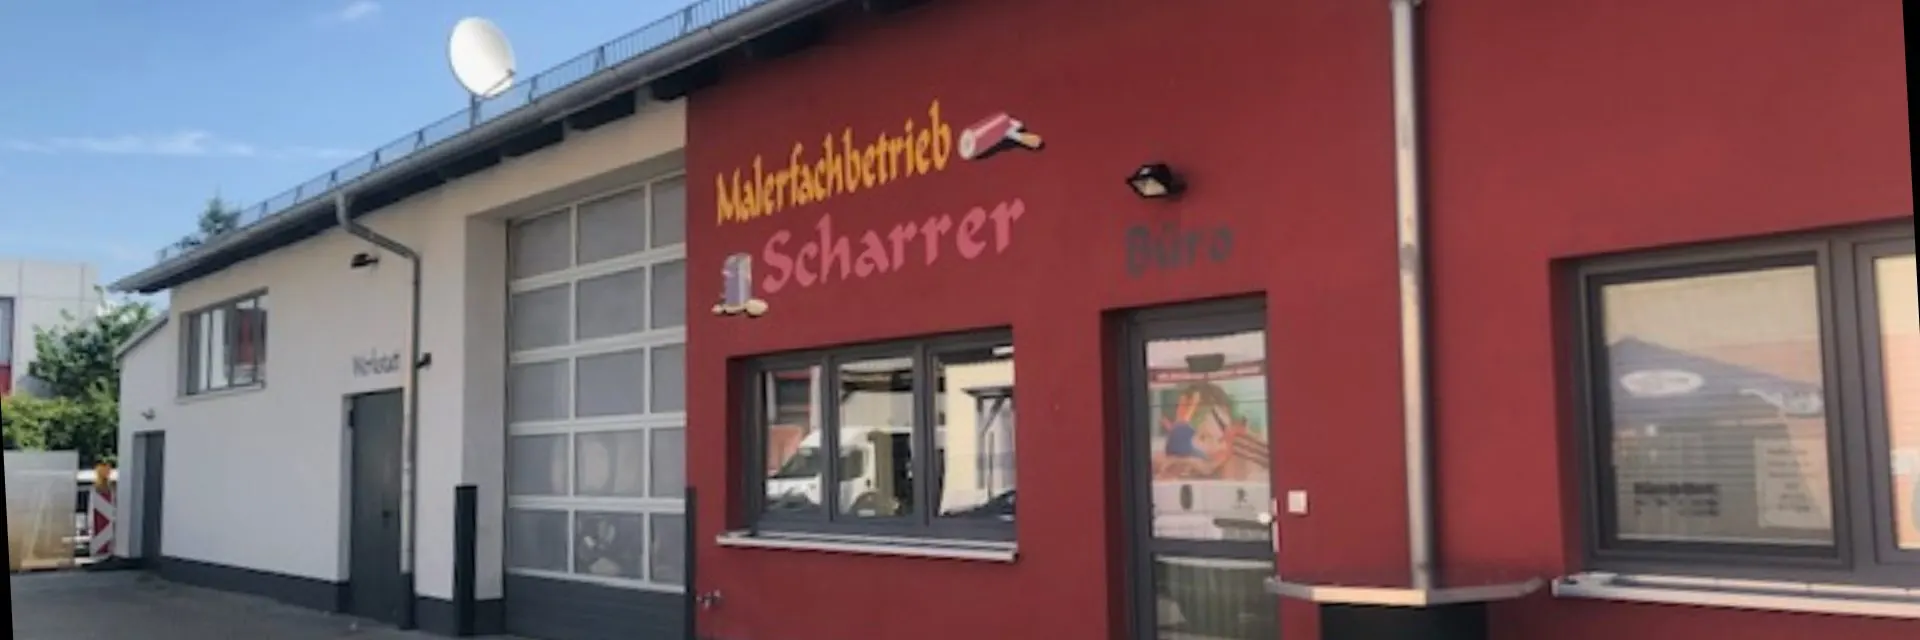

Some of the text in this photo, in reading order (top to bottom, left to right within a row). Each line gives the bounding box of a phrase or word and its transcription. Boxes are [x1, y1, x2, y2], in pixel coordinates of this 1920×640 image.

[716, 99, 950, 226] Malerfachbetrieb
[761, 197, 1026, 293] Scharrer
[1125, 221, 1235, 278] Büro
